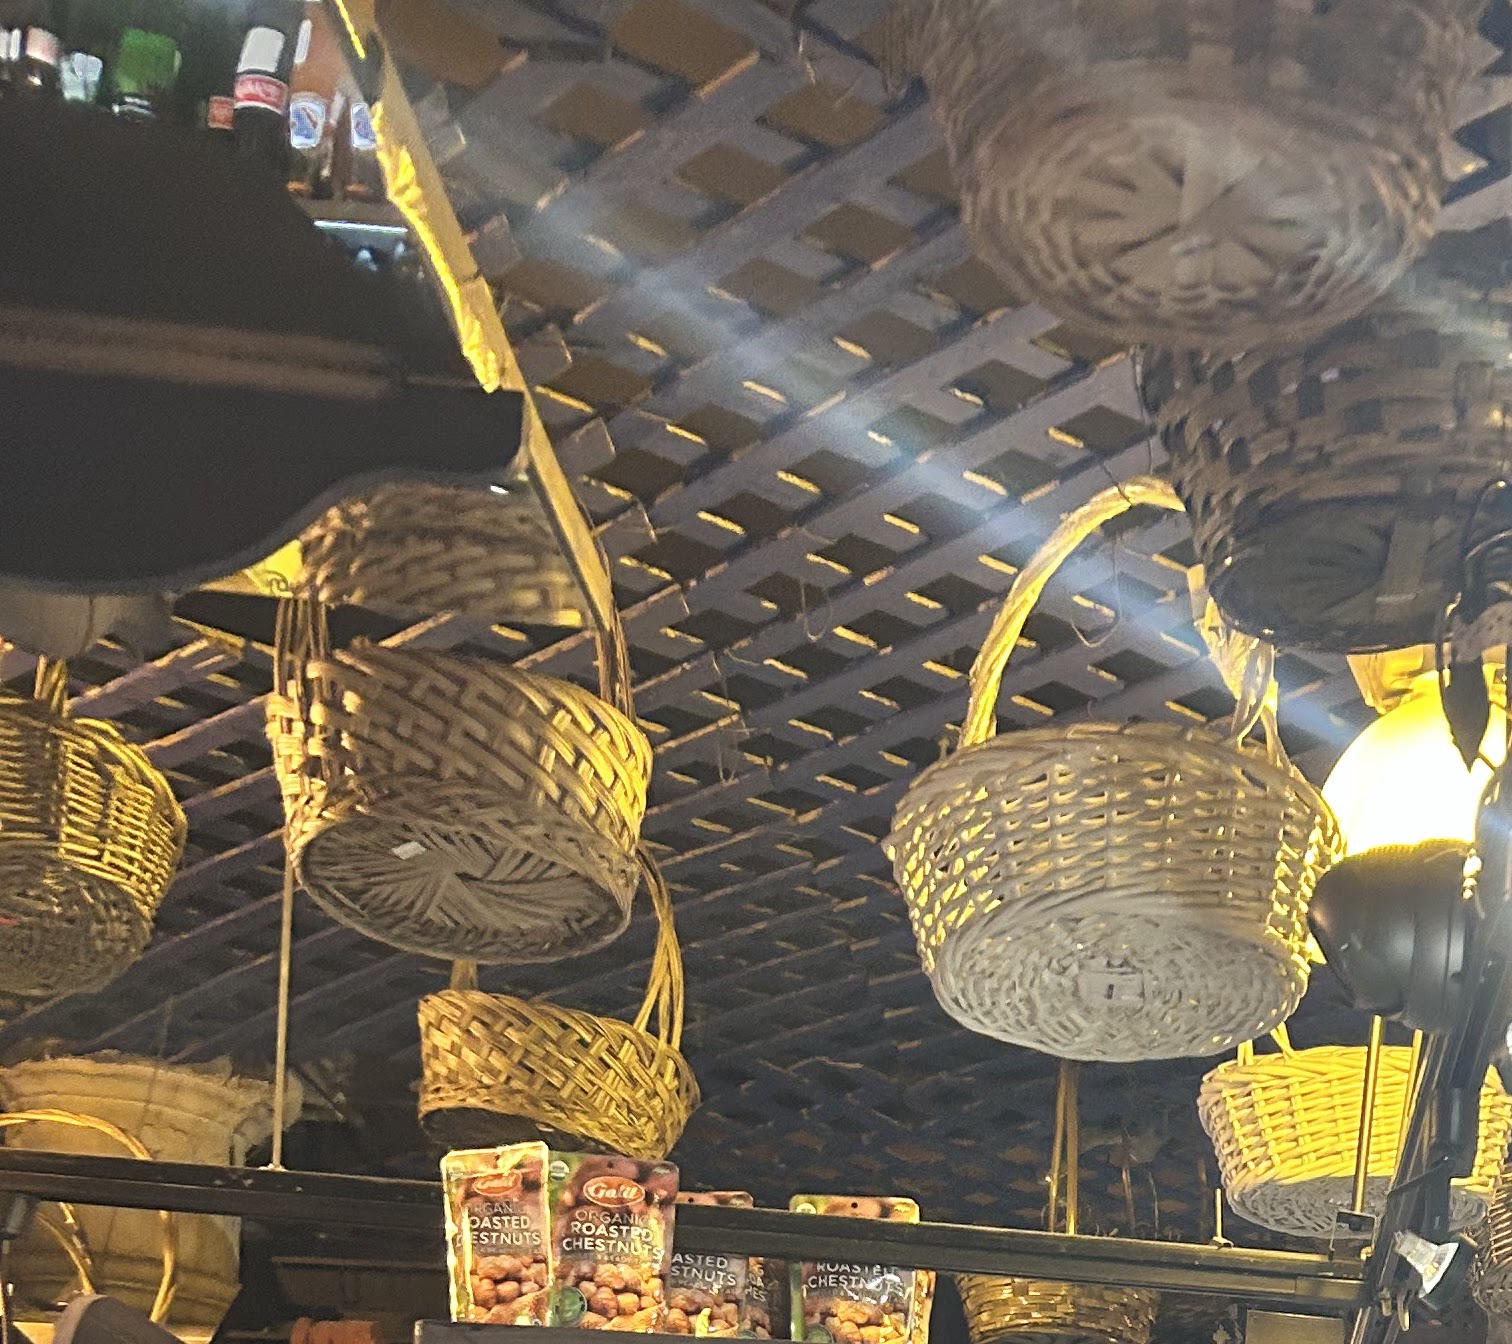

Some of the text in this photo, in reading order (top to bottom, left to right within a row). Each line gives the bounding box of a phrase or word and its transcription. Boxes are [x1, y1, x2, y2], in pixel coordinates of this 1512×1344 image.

[464, 1215, 530, 1229] OASTED
[575, 1209, 650, 1225] ORGANIC
[457, 1230, 542, 1247] CESTNUTS
[571, 1221, 653, 1242] ROASTED
[562, 1237, 664, 1260] CHESTNUTS
[672, 1253, 728, 1269] ASTED
[671, 1267, 737, 1287] STNUTS
